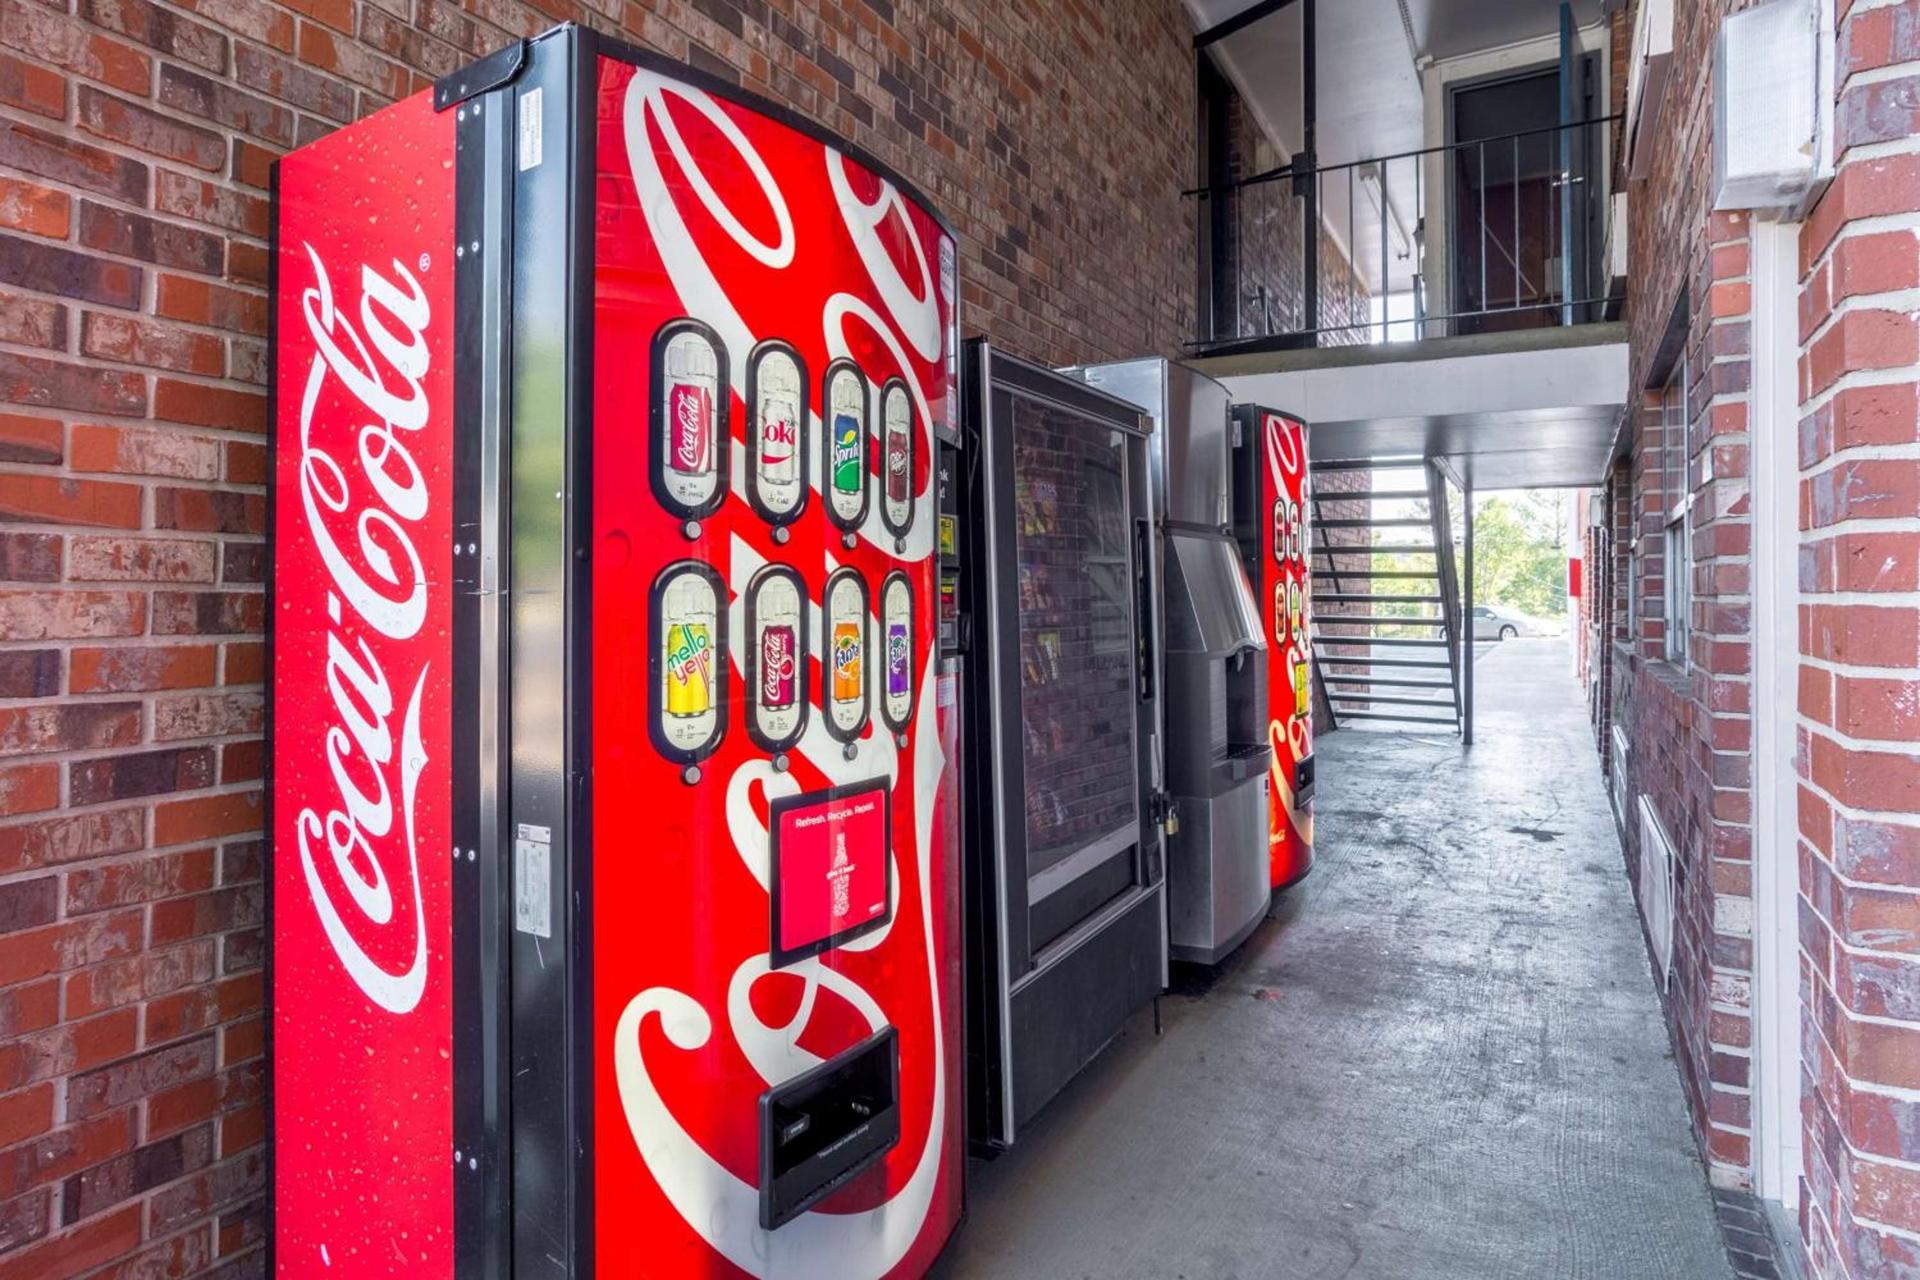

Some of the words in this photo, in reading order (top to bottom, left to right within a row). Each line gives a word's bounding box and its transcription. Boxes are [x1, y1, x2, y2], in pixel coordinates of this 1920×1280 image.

[678, 390, 699, 467] Coca-Cola
[297, 240, 431, 1014] Coca-Cola
[667, 624, 707, 672] mello
[674, 648, 710, 698] yello
[765, 632, 781, 701] Coca-Cola
